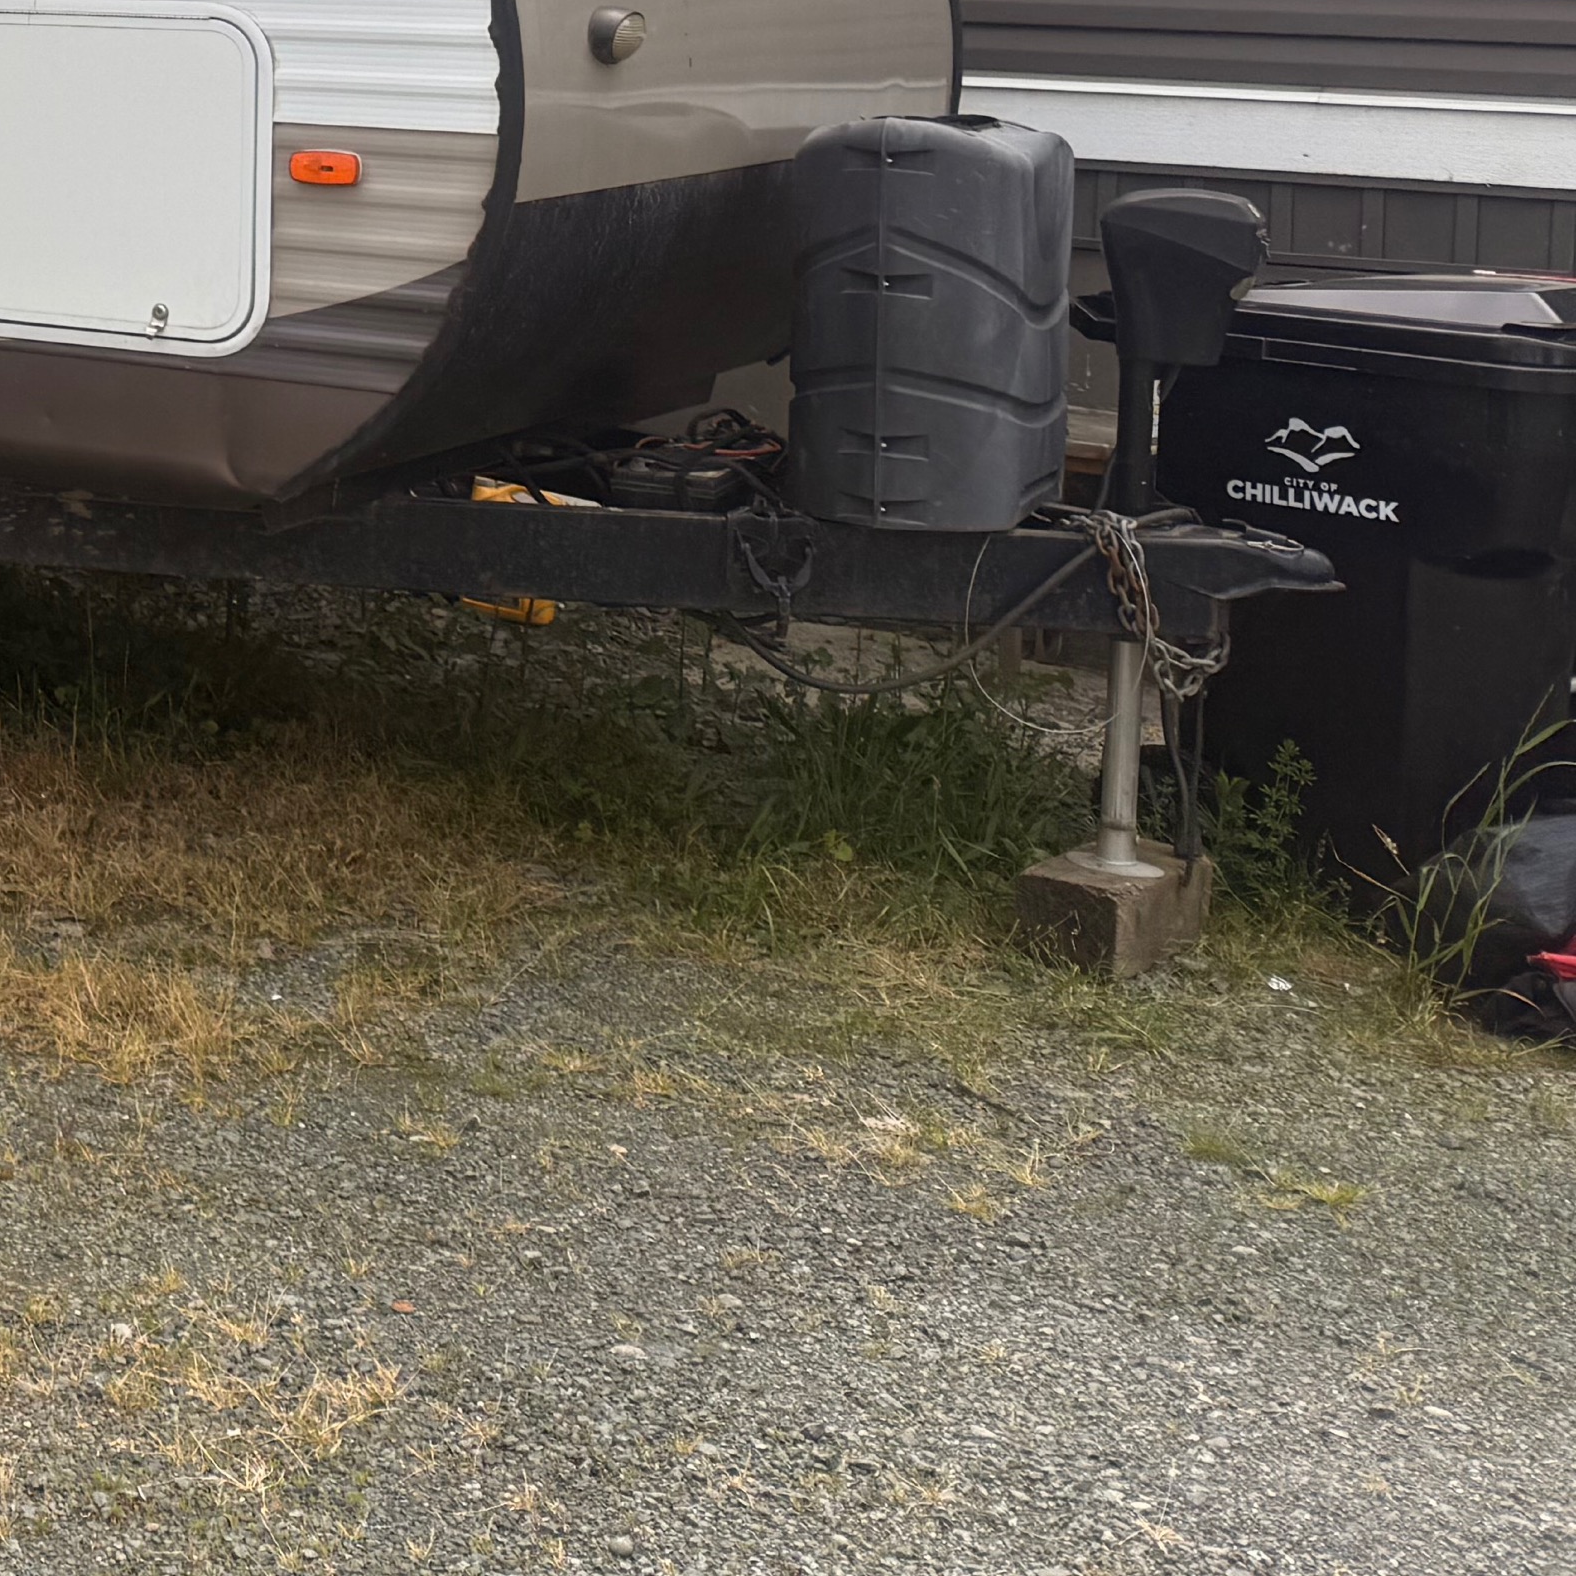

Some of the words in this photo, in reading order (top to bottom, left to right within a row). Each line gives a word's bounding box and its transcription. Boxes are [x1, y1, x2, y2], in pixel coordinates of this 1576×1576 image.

[1284, 477, 1314, 489] CITY
[1320, 482, 1338, 492] OF
[1227, 479, 1400, 523] CHILLIWACK
